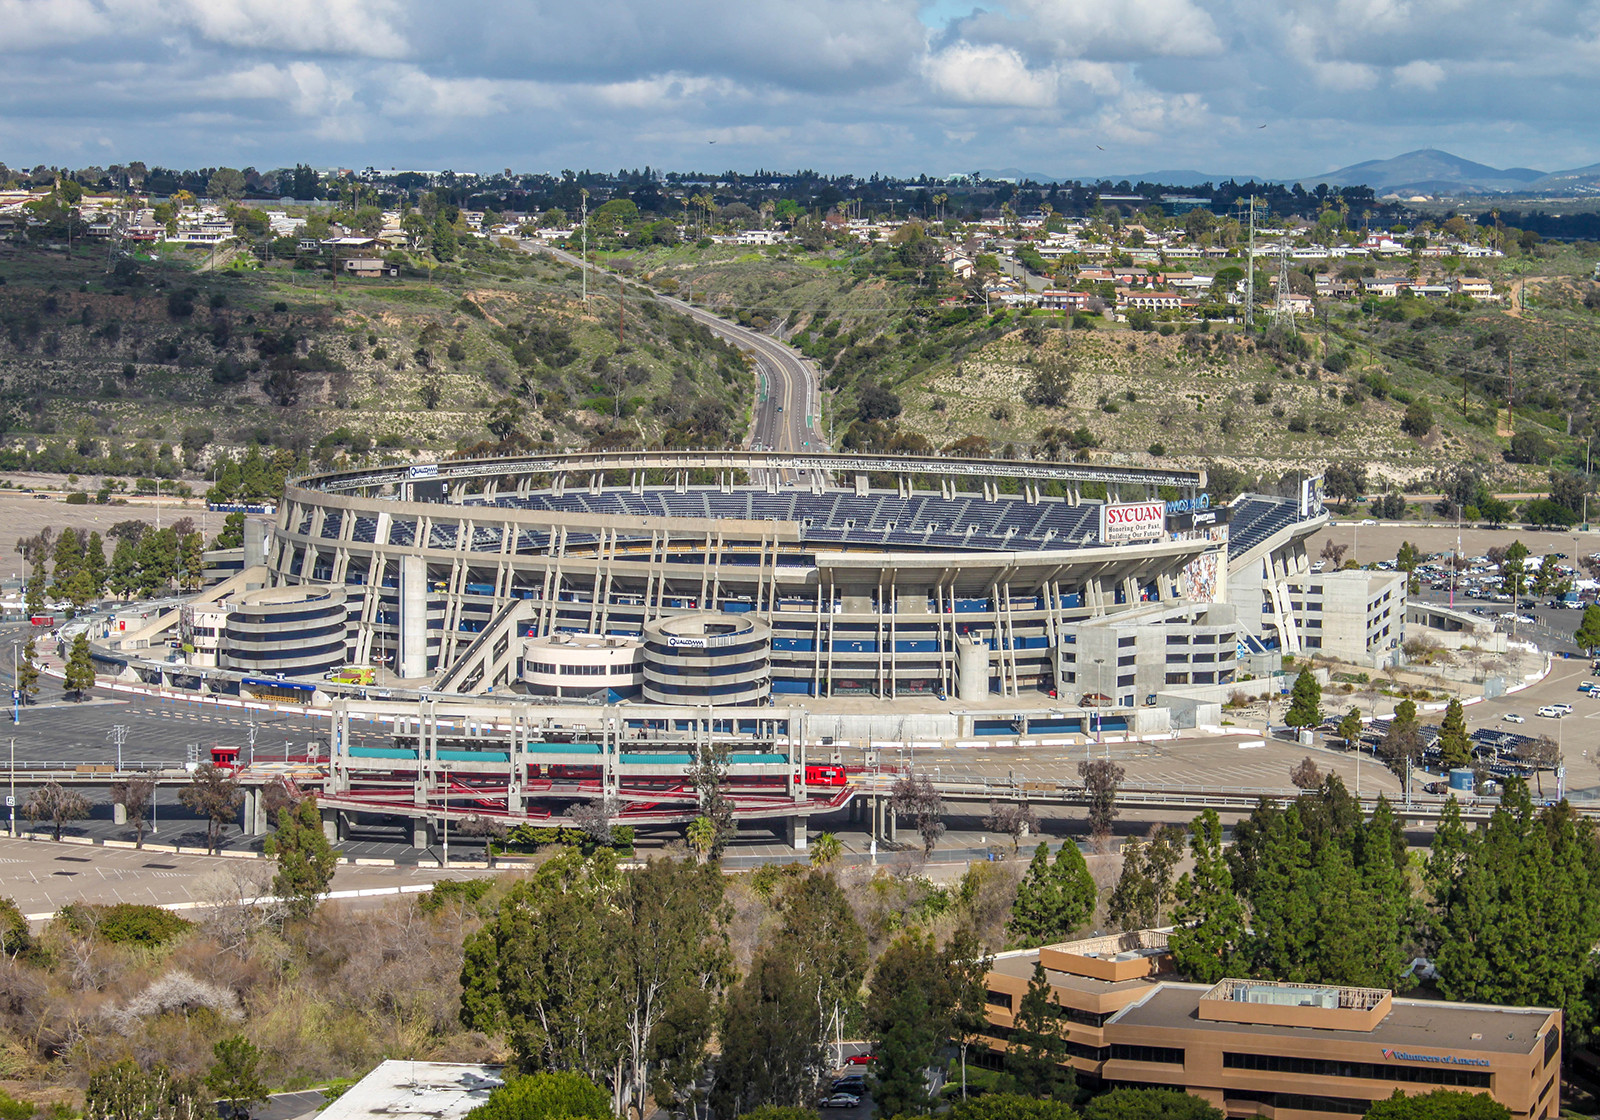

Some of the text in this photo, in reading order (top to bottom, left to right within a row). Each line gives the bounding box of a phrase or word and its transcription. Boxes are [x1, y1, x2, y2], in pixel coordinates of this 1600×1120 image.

[1108, 506, 1162, 524] SYCUAN
[670, 638, 704, 646] QUALCOMM
[1393, 1050, 1440, 1062] Volunteers
[1452, 1056, 1490, 1067] America
